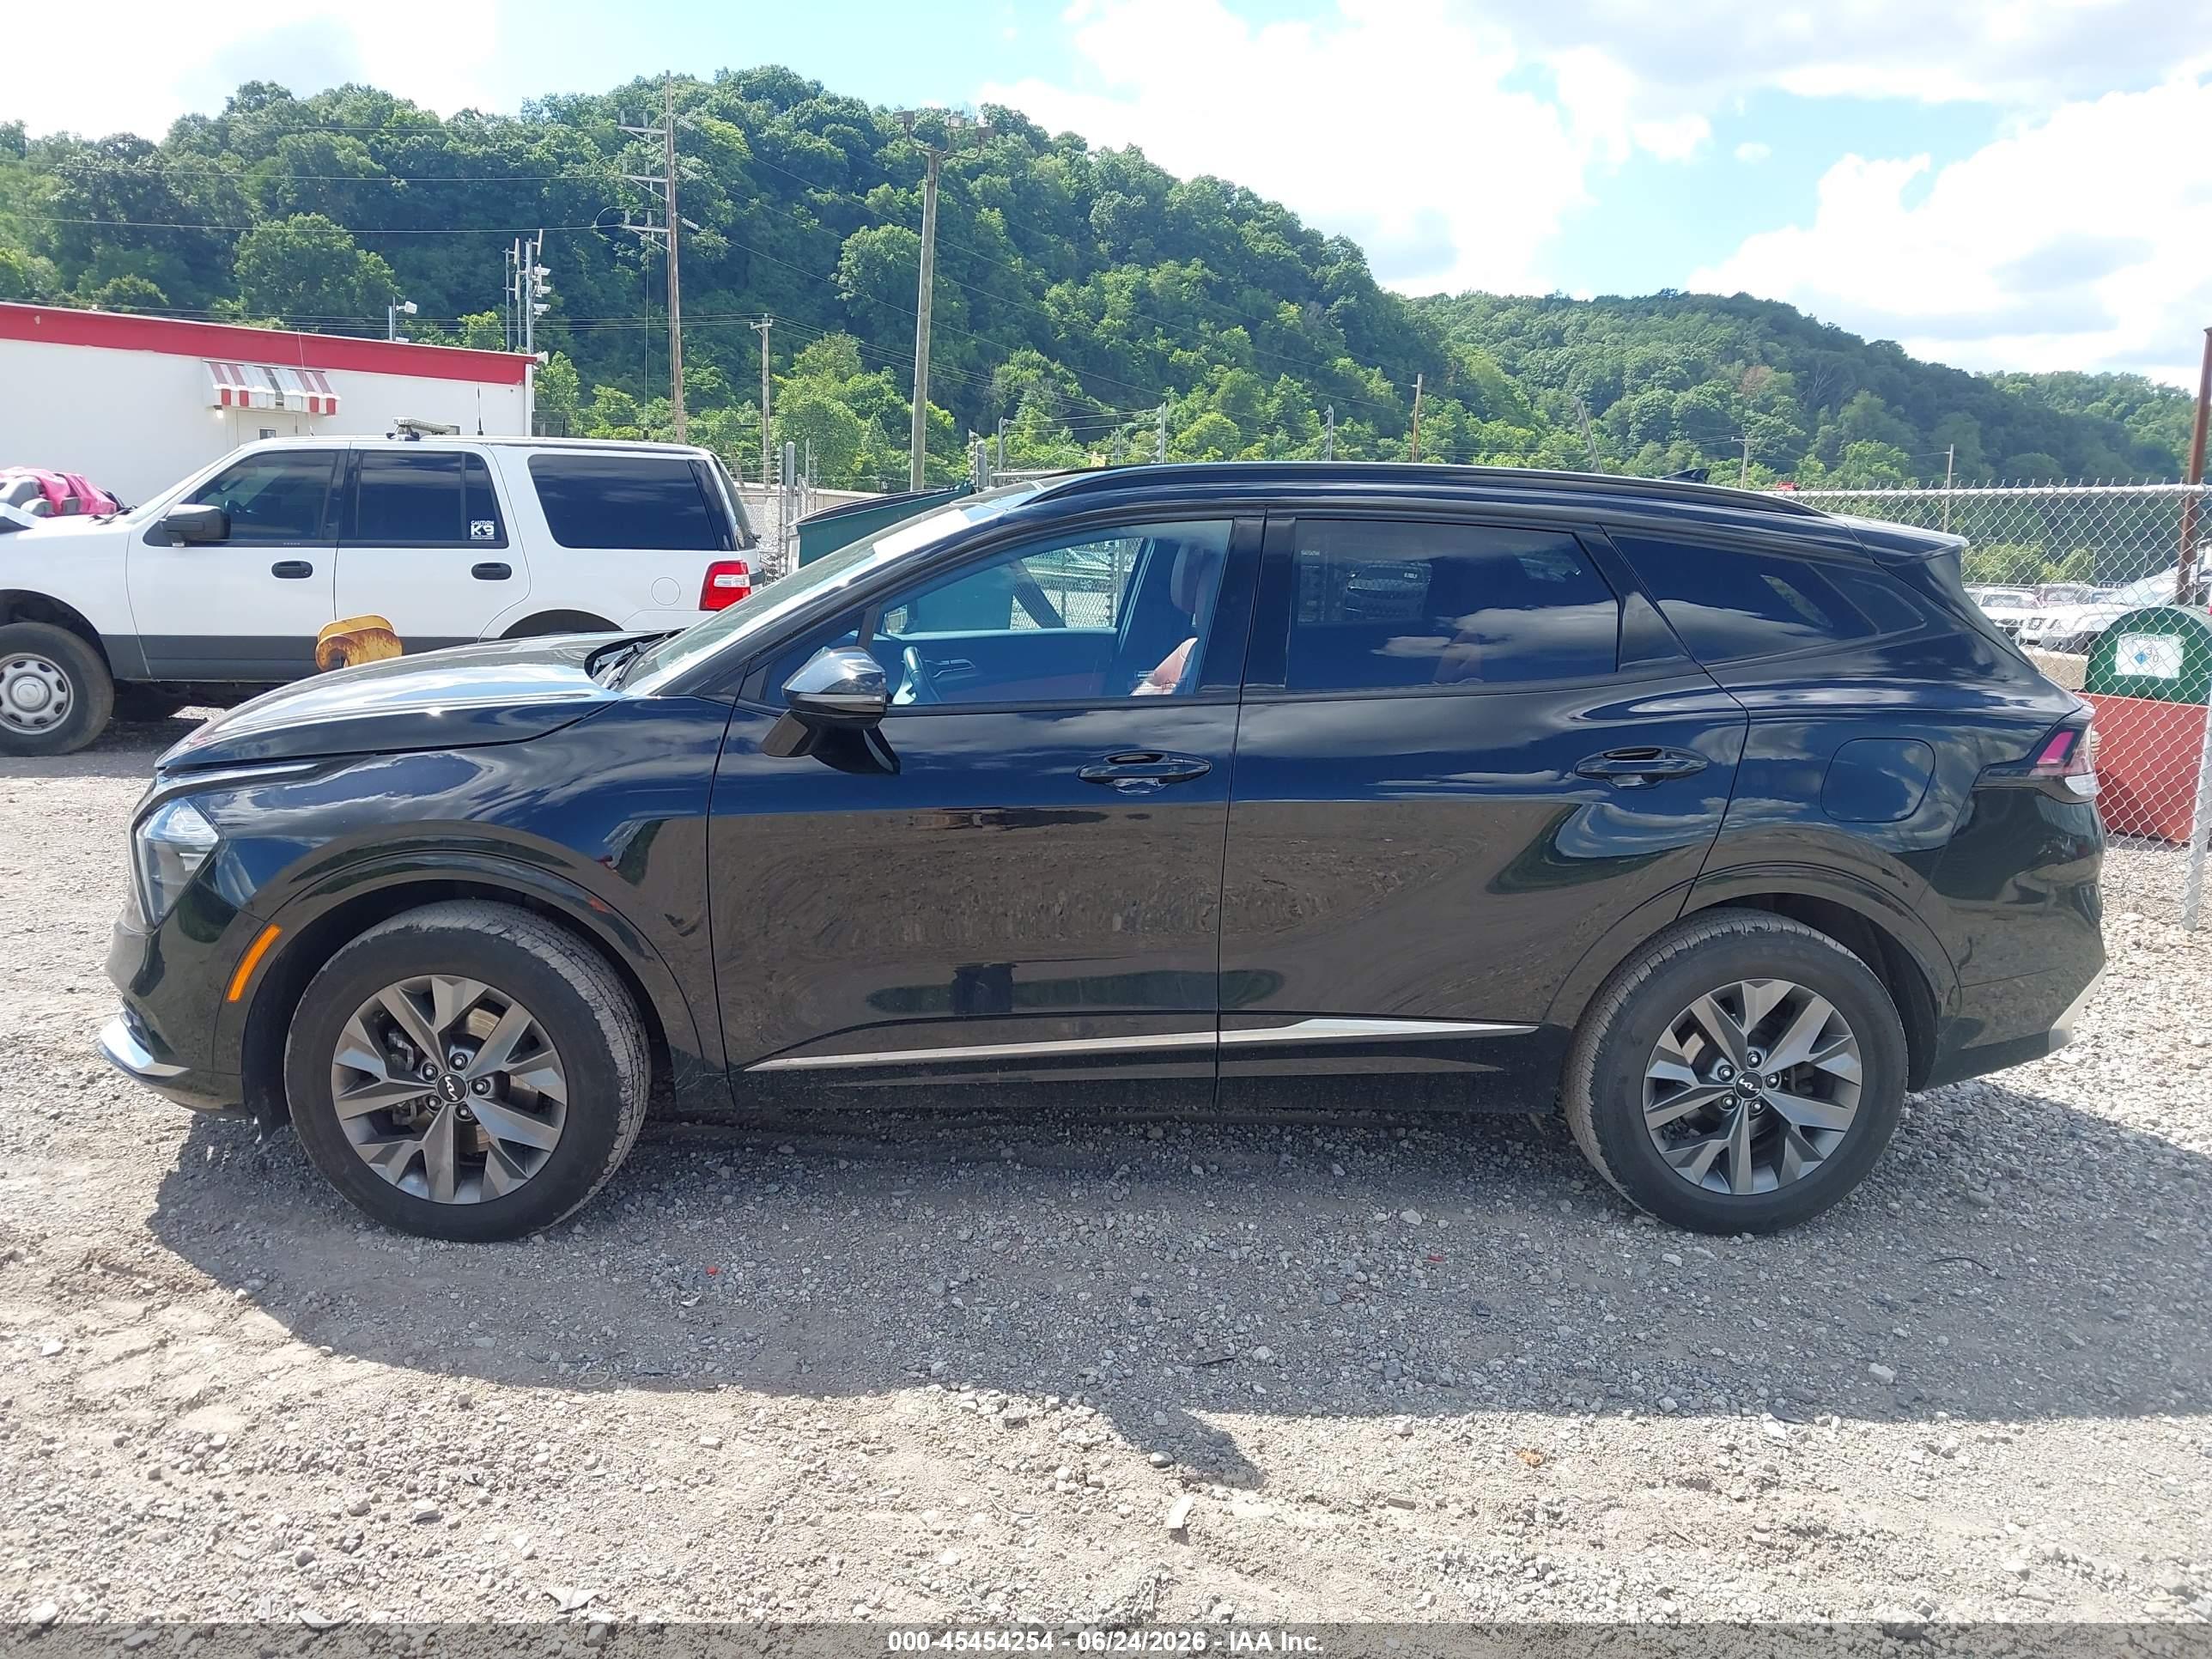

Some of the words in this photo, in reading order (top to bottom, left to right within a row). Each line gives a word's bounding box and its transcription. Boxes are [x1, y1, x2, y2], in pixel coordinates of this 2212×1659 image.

[471, 525, 495, 536] K9
[2133, 635, 2172, 643] GASOLINE
[2152, 654, 2160, 664] 0
